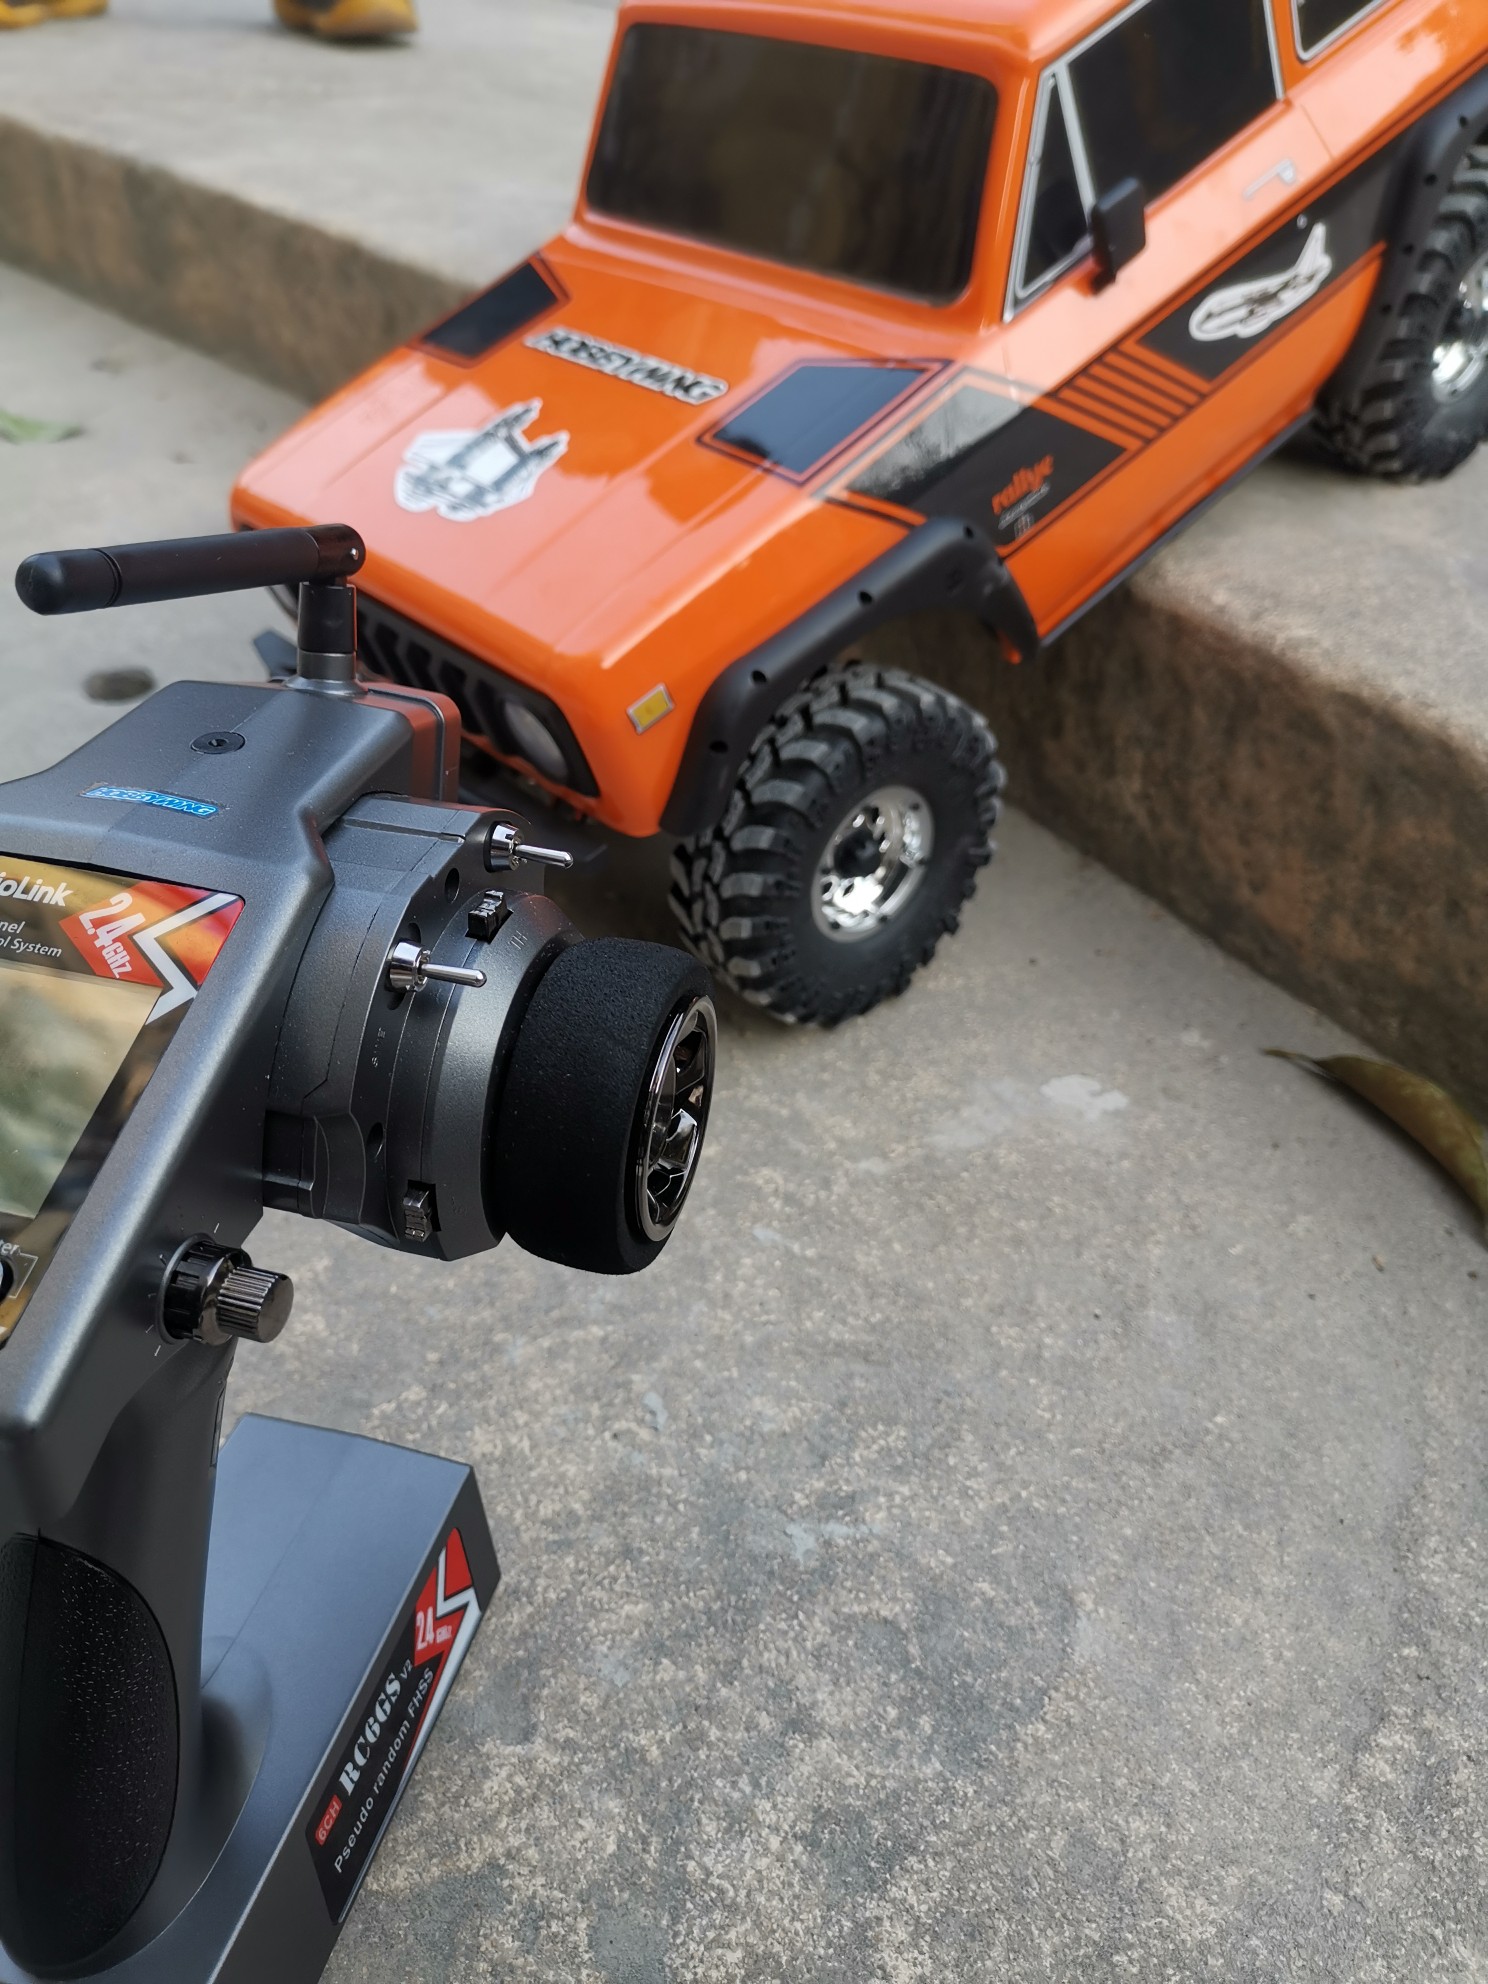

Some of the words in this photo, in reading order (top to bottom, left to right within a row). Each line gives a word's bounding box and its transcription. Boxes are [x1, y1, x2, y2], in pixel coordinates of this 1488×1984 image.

[10, 938, 62, 957] System
[317, 1801, 341, 1841] 6CH
[338, 1672, 401, 1796] RC6GS
[334, 1798, 374, 1873] Pseudo
[374, 1719, 411, 1794] random
[407, 1667, 434, 1719] FHSS
